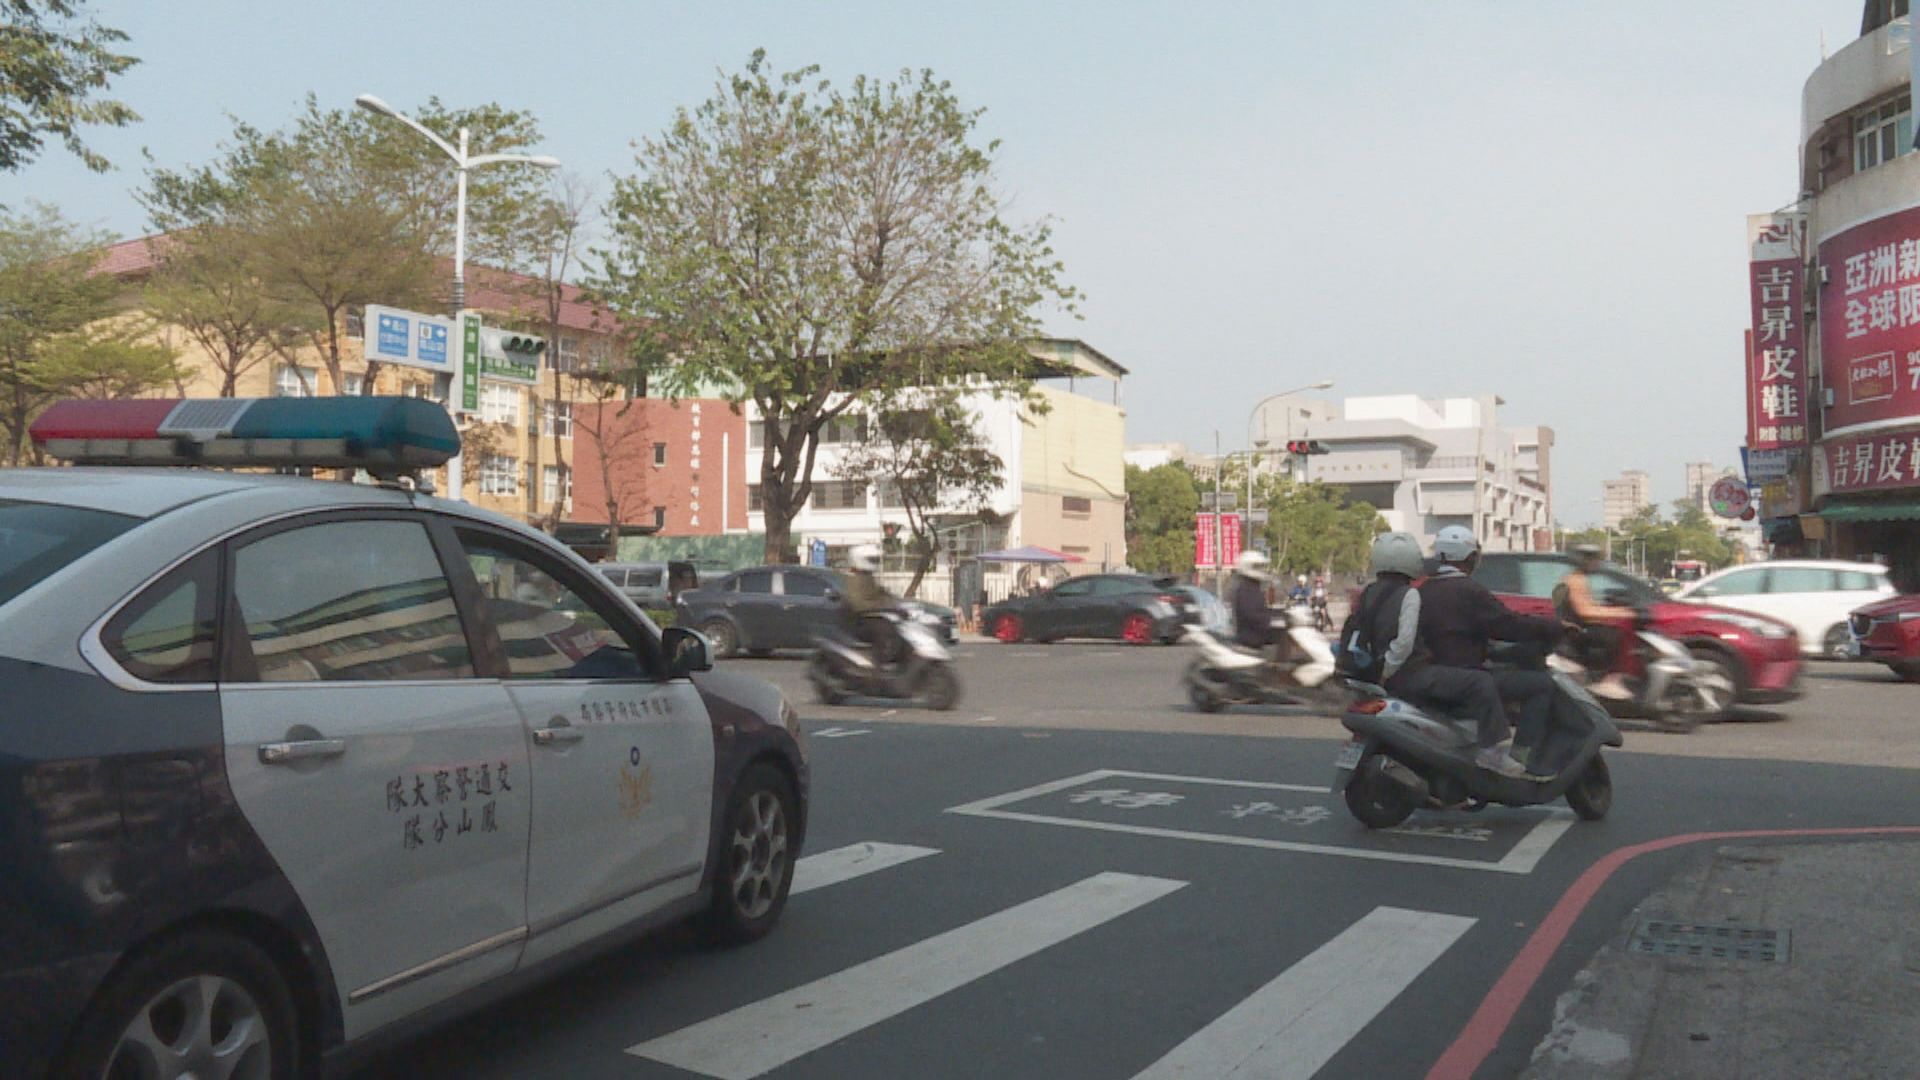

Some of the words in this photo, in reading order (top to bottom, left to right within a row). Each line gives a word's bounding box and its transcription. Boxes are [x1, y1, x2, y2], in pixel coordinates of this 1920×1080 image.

[1845, 238, 1920, 295] 亞洲新
[1845, 283, 1920, 339] 全球限
[1758, 266, 1799, 420] 吉昇皮鞋
